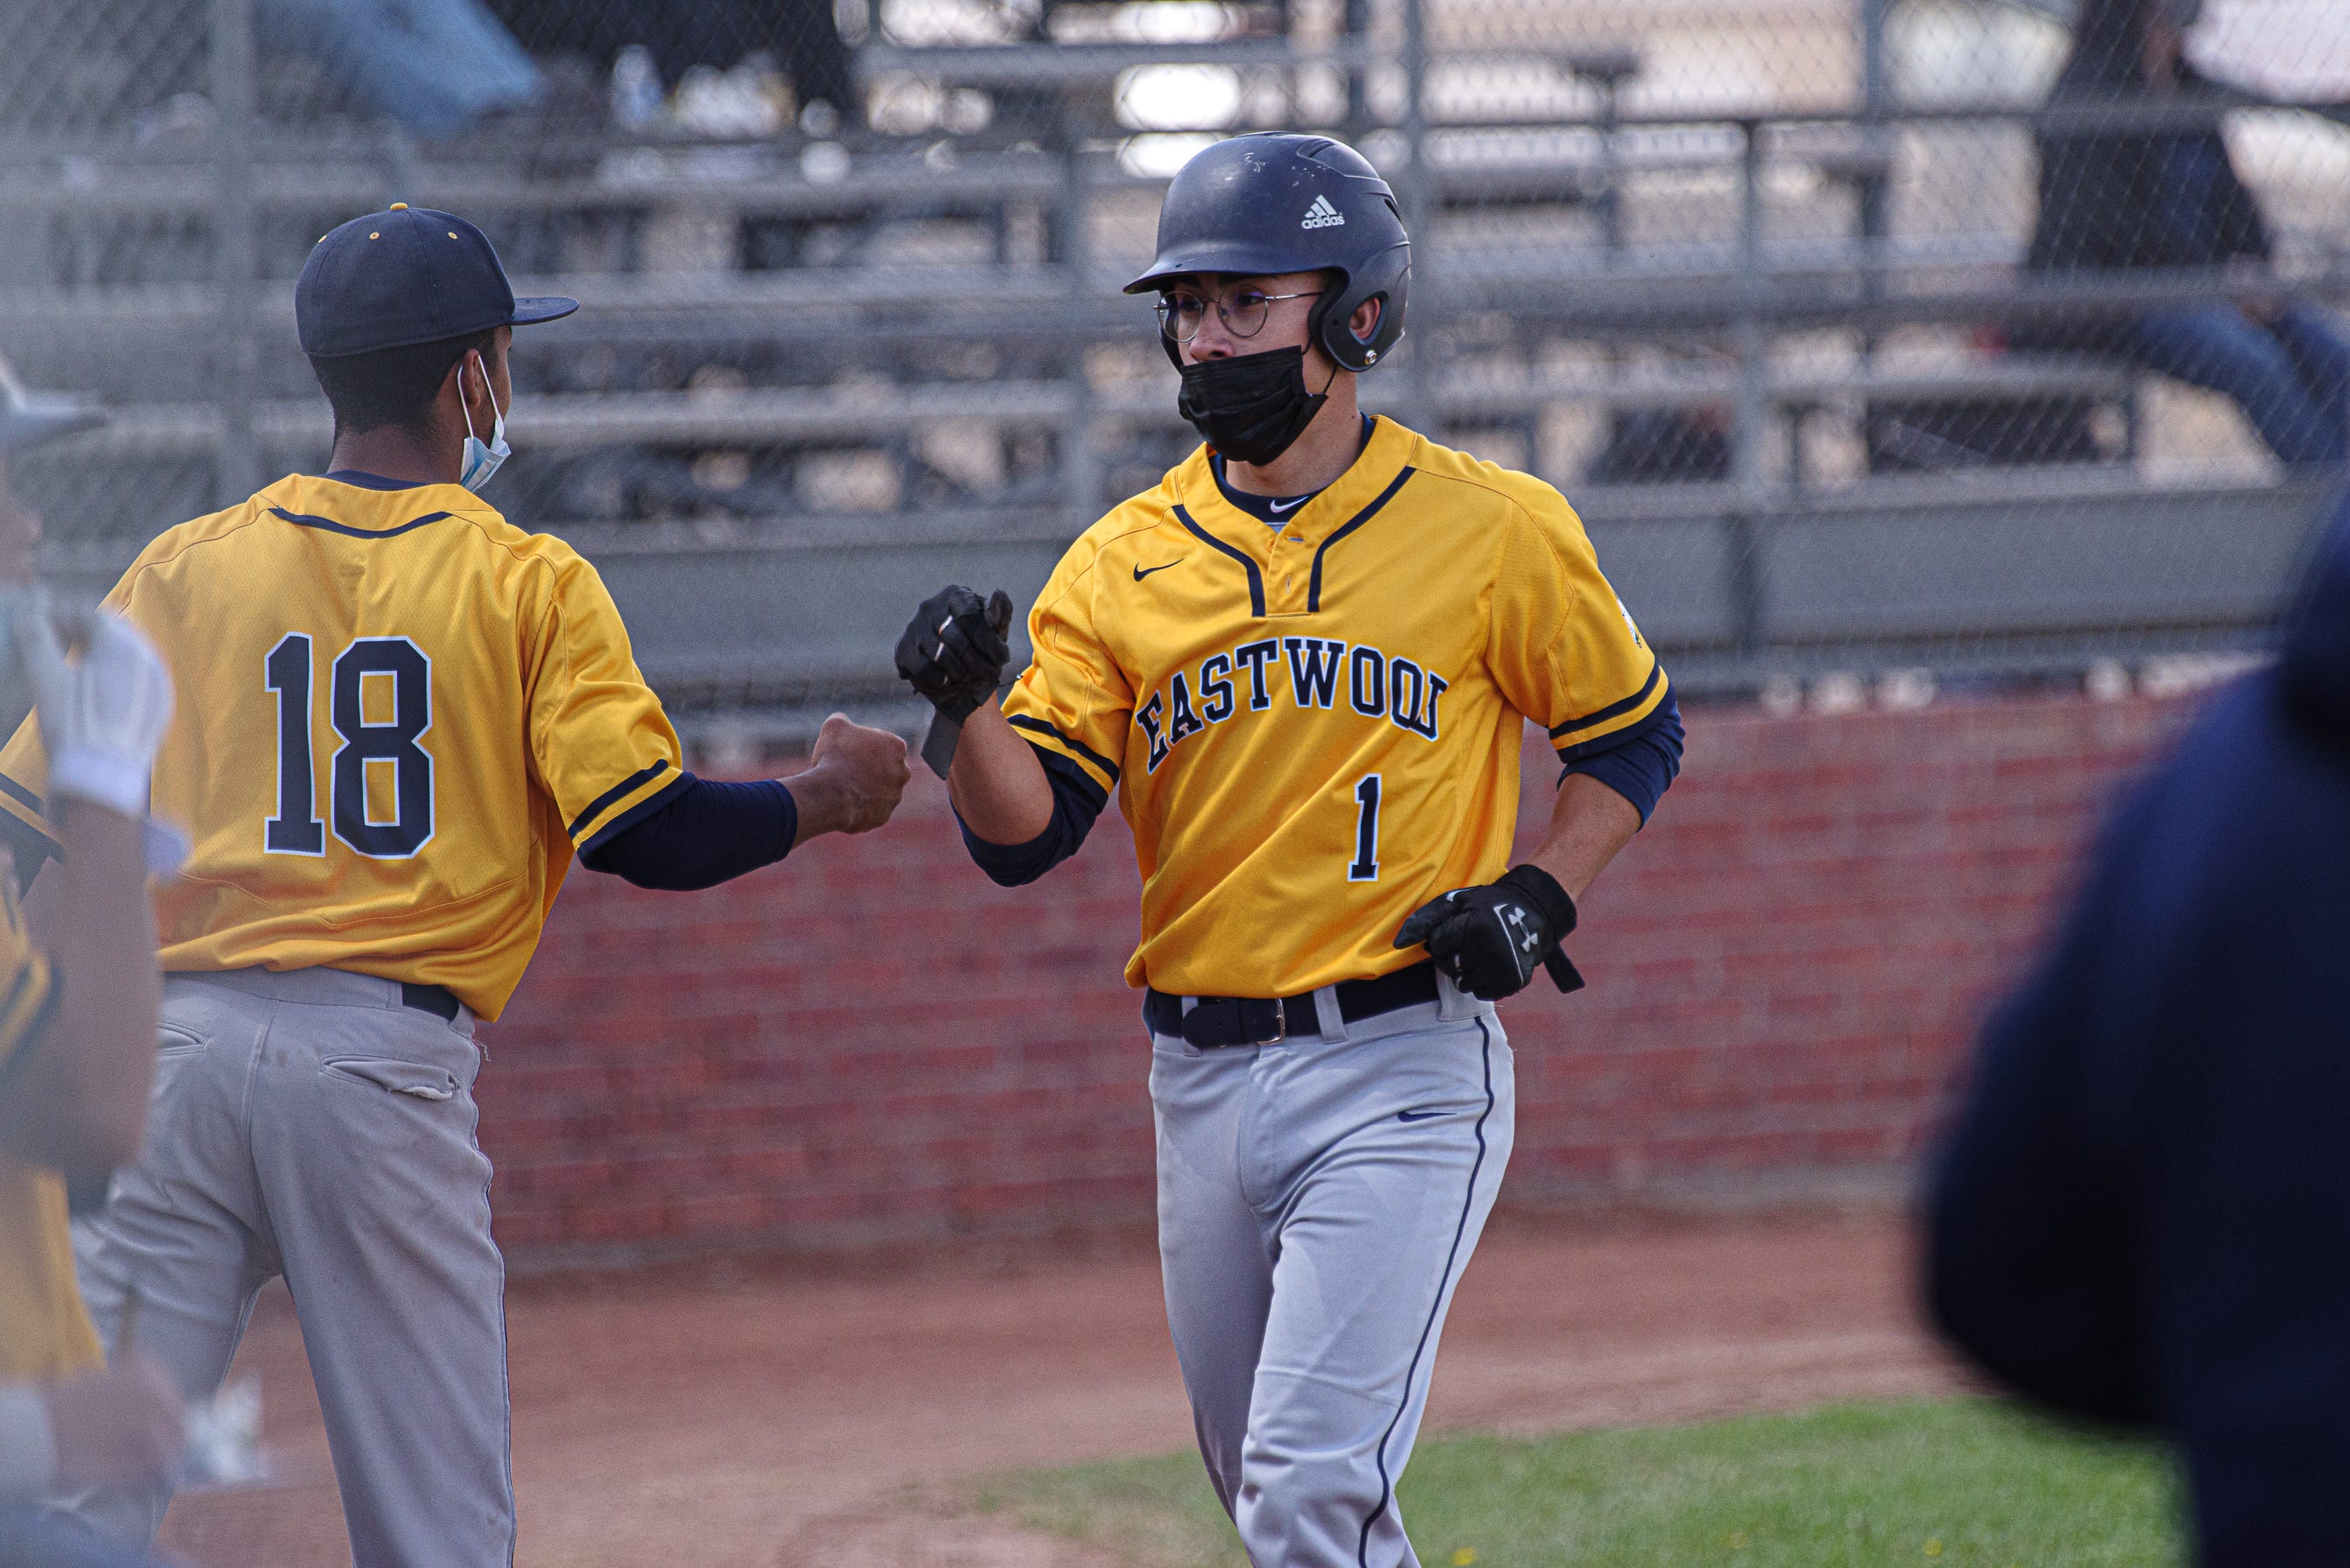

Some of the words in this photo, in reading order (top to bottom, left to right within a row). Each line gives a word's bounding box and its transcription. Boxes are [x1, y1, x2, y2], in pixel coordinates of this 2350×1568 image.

[1301, 214, 1345, 230] adidas
[264, 632, 435, 860] 18
[1347, 774, 1381, 882] 1
